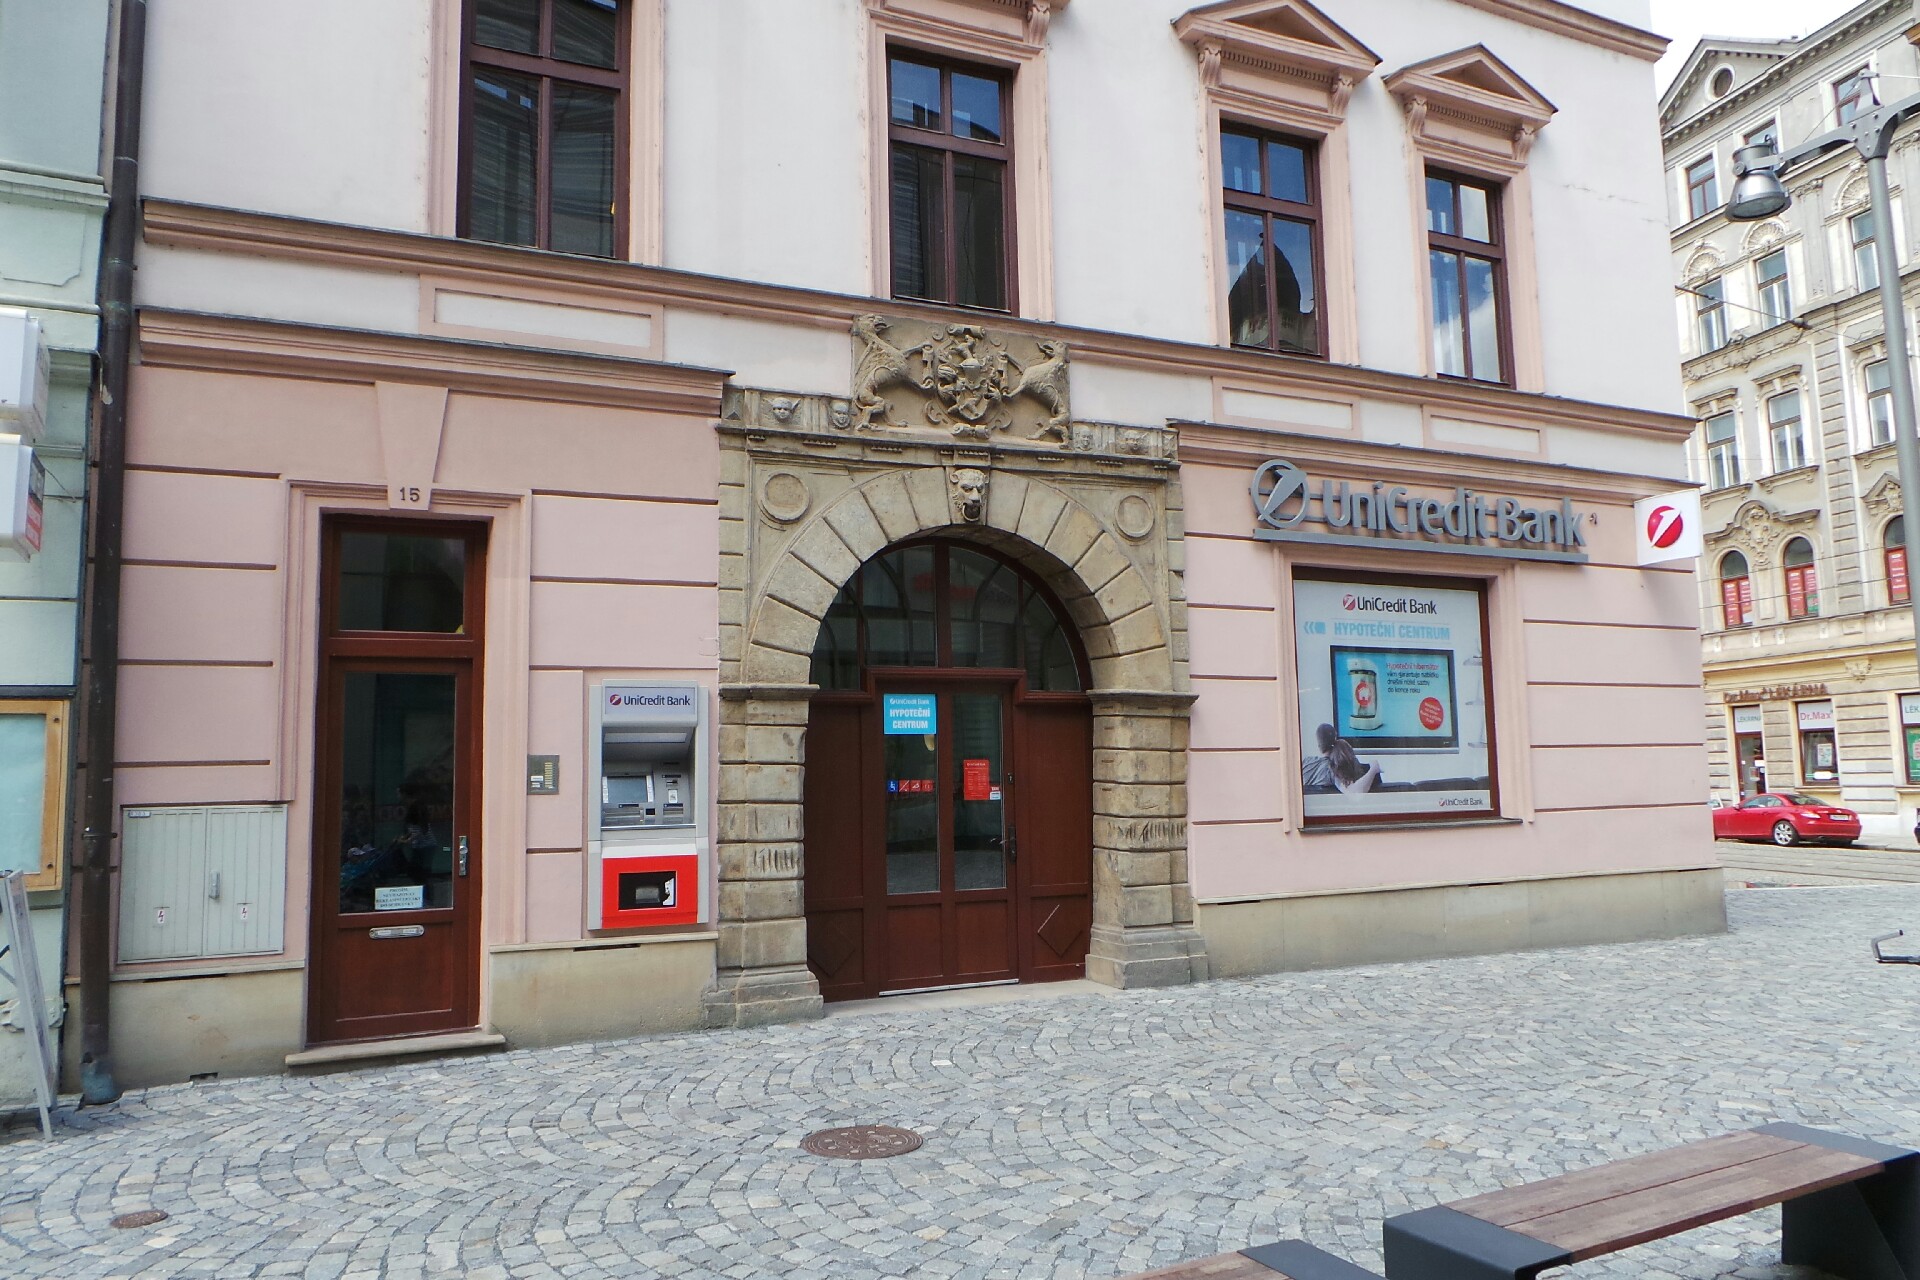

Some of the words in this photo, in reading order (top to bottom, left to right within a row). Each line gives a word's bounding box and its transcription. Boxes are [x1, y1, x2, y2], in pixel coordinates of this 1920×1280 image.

[399, 486, 420, 502] 15
[1322, 480, 1490, 540] UniCredit
[1497, 496, 1586, 547] Bank
[1357, 596, 1407, 613] UniCredit
[1409, 598, 1437, 615] Bank
[1334, 620, 1396, 638] HYPOTEČNÍ
[1398, 624, 1450, 641] CENTRUM
[624, 694, 665, 706] UniCredit
[667, 695, 690, 706] Bank
[890, 708, 930, 718] HYPOTEČNÍ
[1800, 711, 1831, 721] Dr.Max
[892, 720, 928, 728] CENTRUM
[1446, 798, 1469, 806] UniCredit
[1470, 798, 1484, 806] Bank
